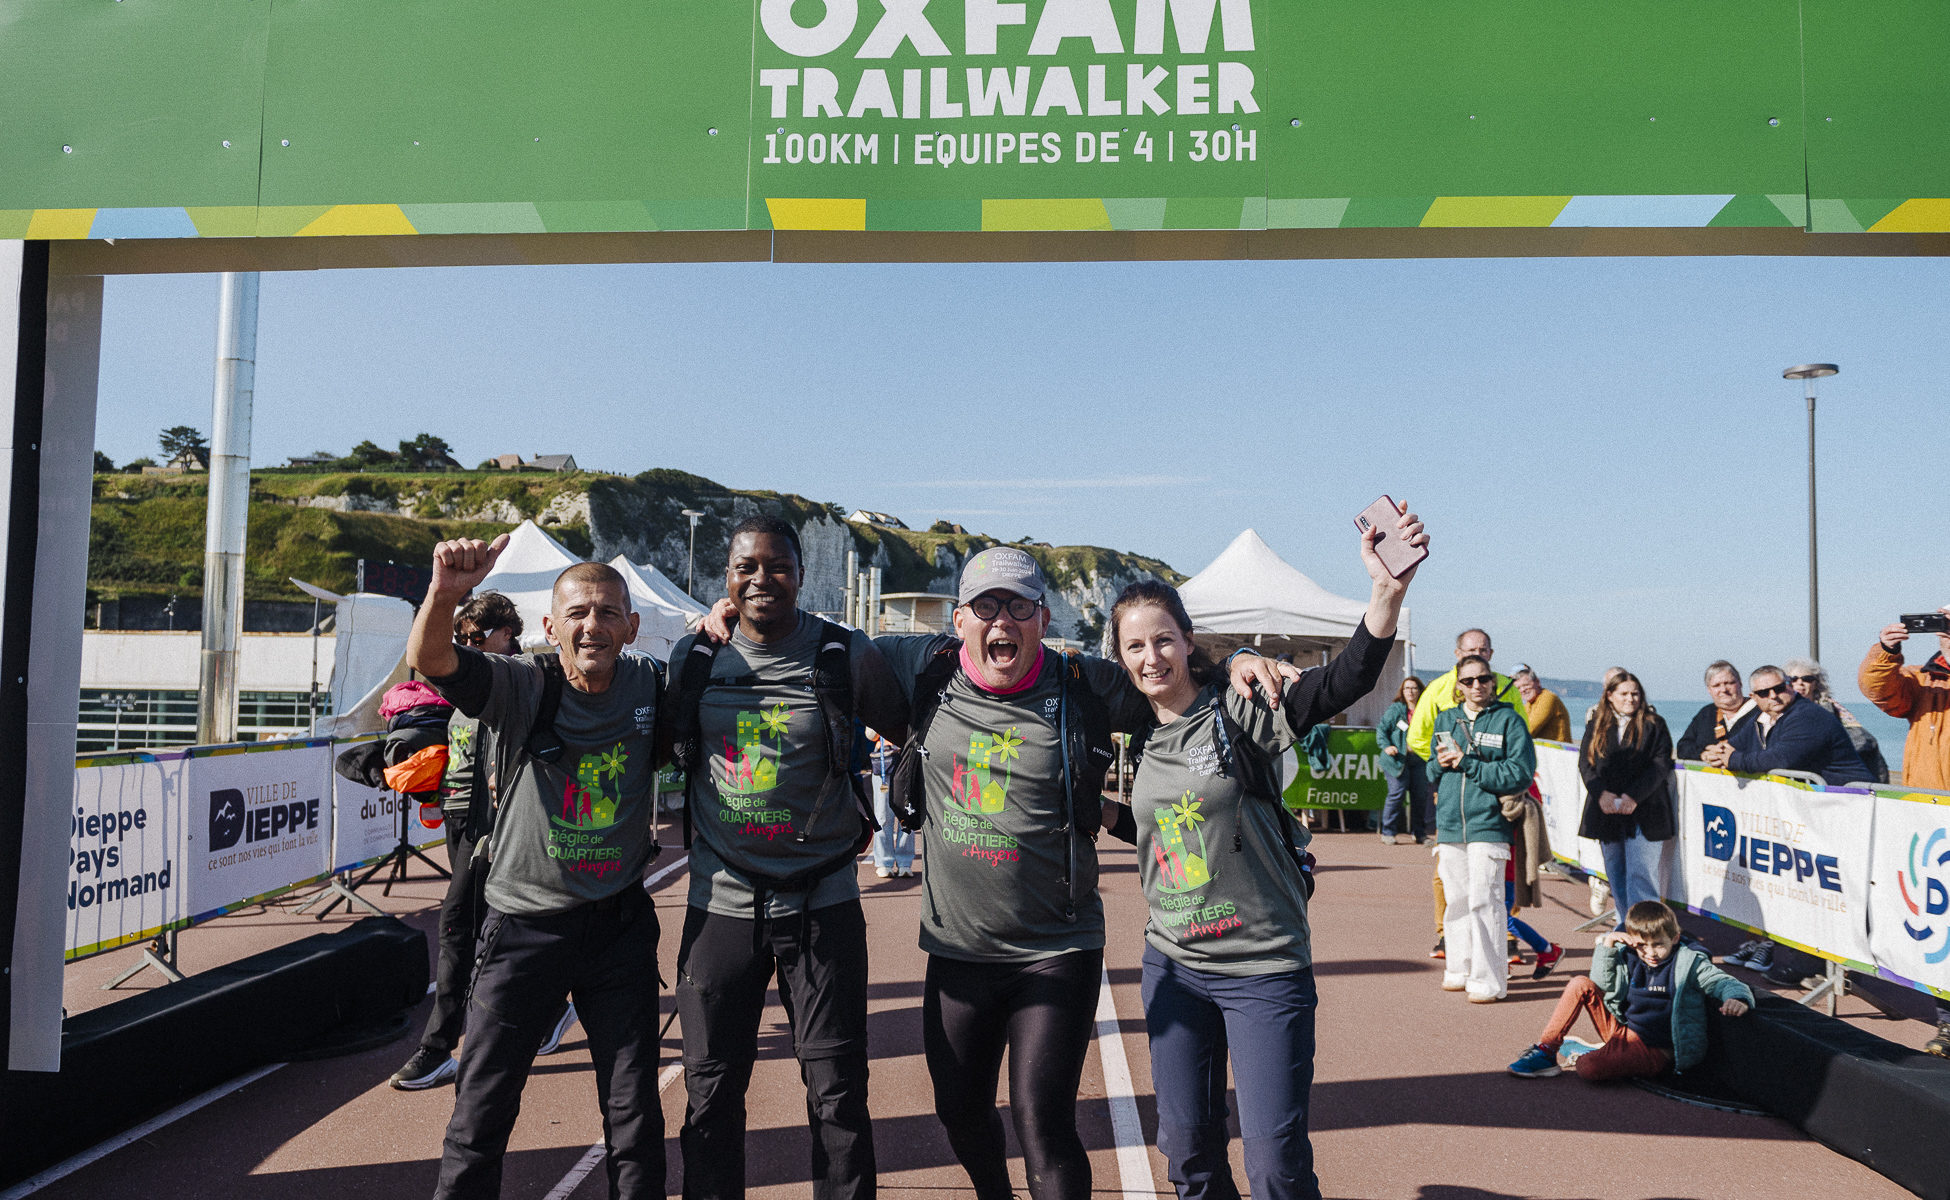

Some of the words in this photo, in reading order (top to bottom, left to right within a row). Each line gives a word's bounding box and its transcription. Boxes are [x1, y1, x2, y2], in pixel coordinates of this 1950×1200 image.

[759, 61, 1261, 119] TRAILWALKER
[763, 132, 879, 165] 100KM
[914, 131, 1062, 168] EQUIPES
[1075, 131, 1120, 163] DE
[1132, 131, 1154, 162] 4
[1188, 129, 1257, 162] 30H
[995, 552, 1027, 562] OXFAM
[1190, 743, 1216, 757] OXFA
[247, 784, 279, 806] VILLE
[282, 781, 297, 801] DE
[719, 792, 752, 811] Régie
[753, 798, 766, 807] de
[1307, 788, 1358, 804] France
[361, 800, 377, 820] du
[719, 809, 792, 824] QUARTIERS
[209, 788, 319, 853] DIEPPE
[943, 810, 978, 831] Régie
[980, 821, 993, 830] de
[1741, 811, 1780, 838] VILLE
[548, 828, 589, 846] Régie
[591, 834, 604, 844] de
[942, 828, 1018, 848] QUARTIERS
[208, 858, 217, 871] ce
[219, 854, 236, 868] sont
[238, 848, 251, 864] nos
[252, 845, 267, 859] vies
[268, 840, 280, 860] qui
[281, 836, 297, 852] font
[299, 834, 305, 847] la
[547, 845, 623, 860] QUARTIERS
[962, 843, 1020, 867] d'Angers
[1702, 803, 1843, 894] DIEPPE
[1732, 872, 1746, 885] nos
[1159, 894, 1191, 913] Régie
[1191, 894, 1206, 905] de
[1162, 901, 1236, 928] QUARTIERS
